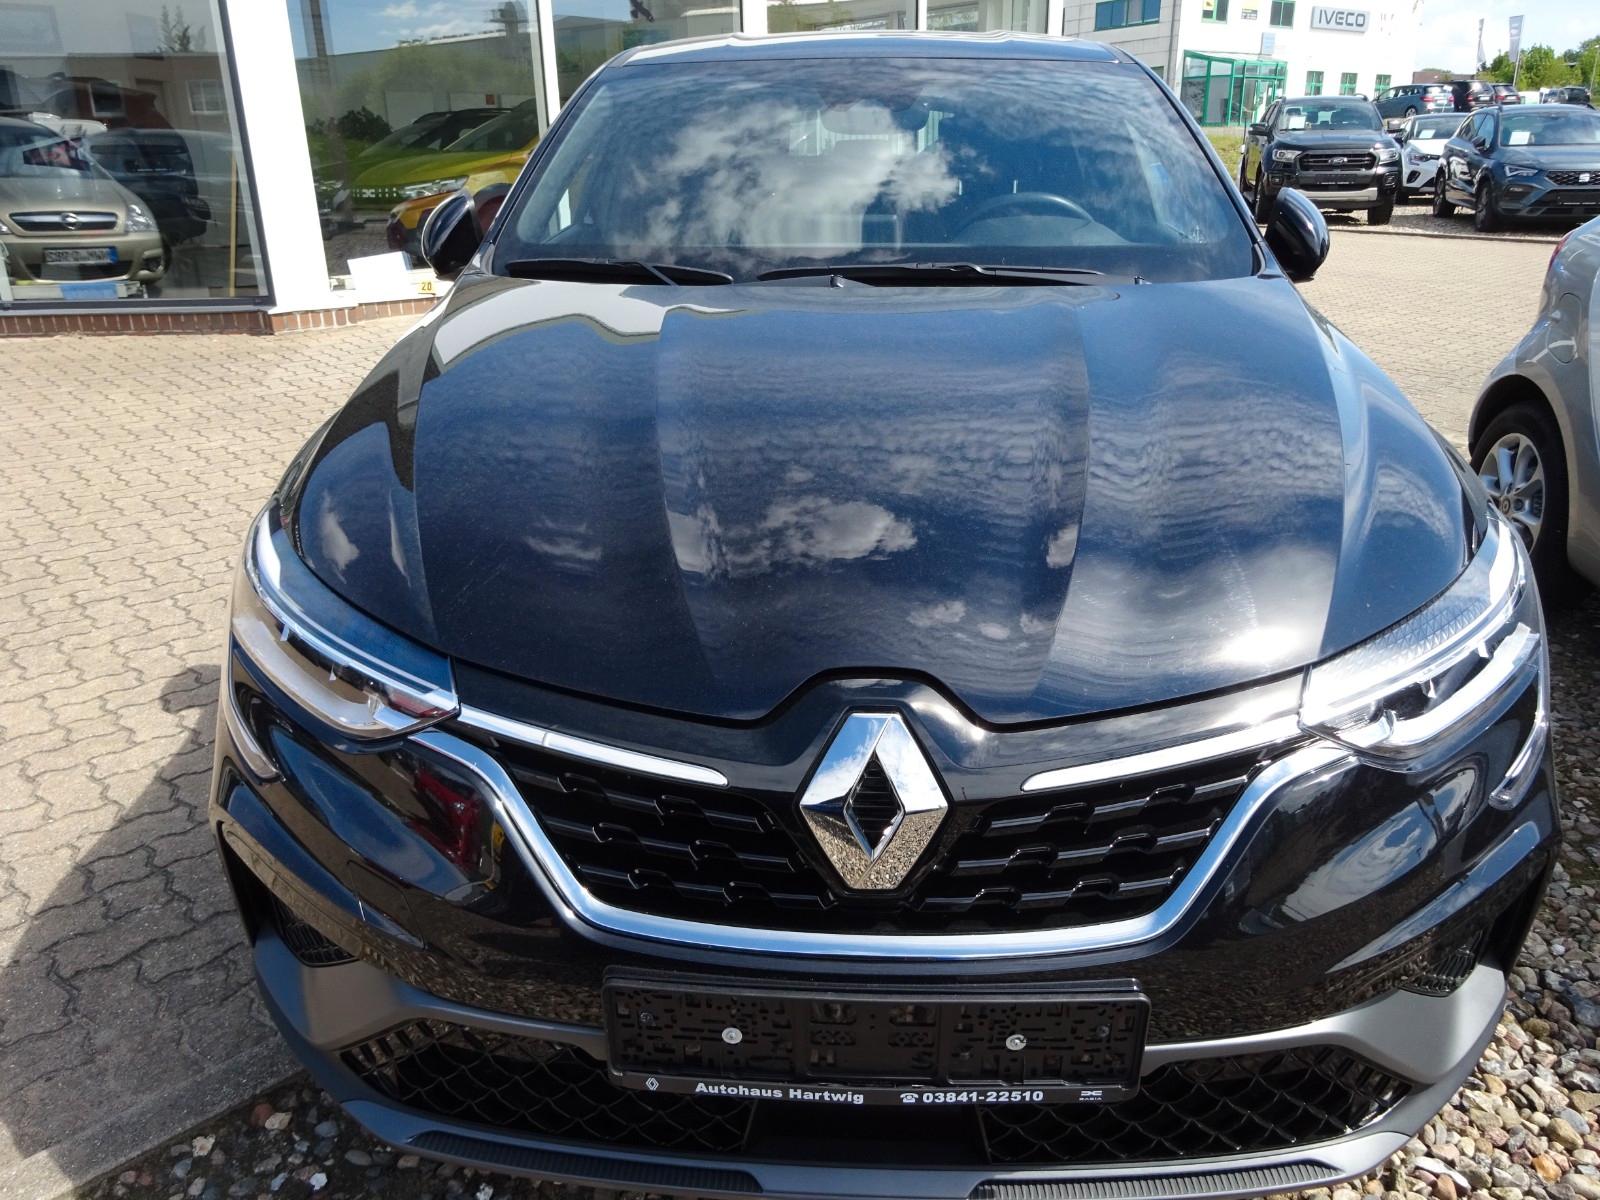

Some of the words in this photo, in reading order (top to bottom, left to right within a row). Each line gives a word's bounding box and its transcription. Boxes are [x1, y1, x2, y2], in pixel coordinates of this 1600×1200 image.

[1318, 9, 1366, 27] IVECO
[421, 281, 432, 291] 20
[695, 1082, 783, 1098] Autohaus
[789, 1088, 864, 1105] Hartwig
[922, 1090, 1044, 1103] 03841-22510
